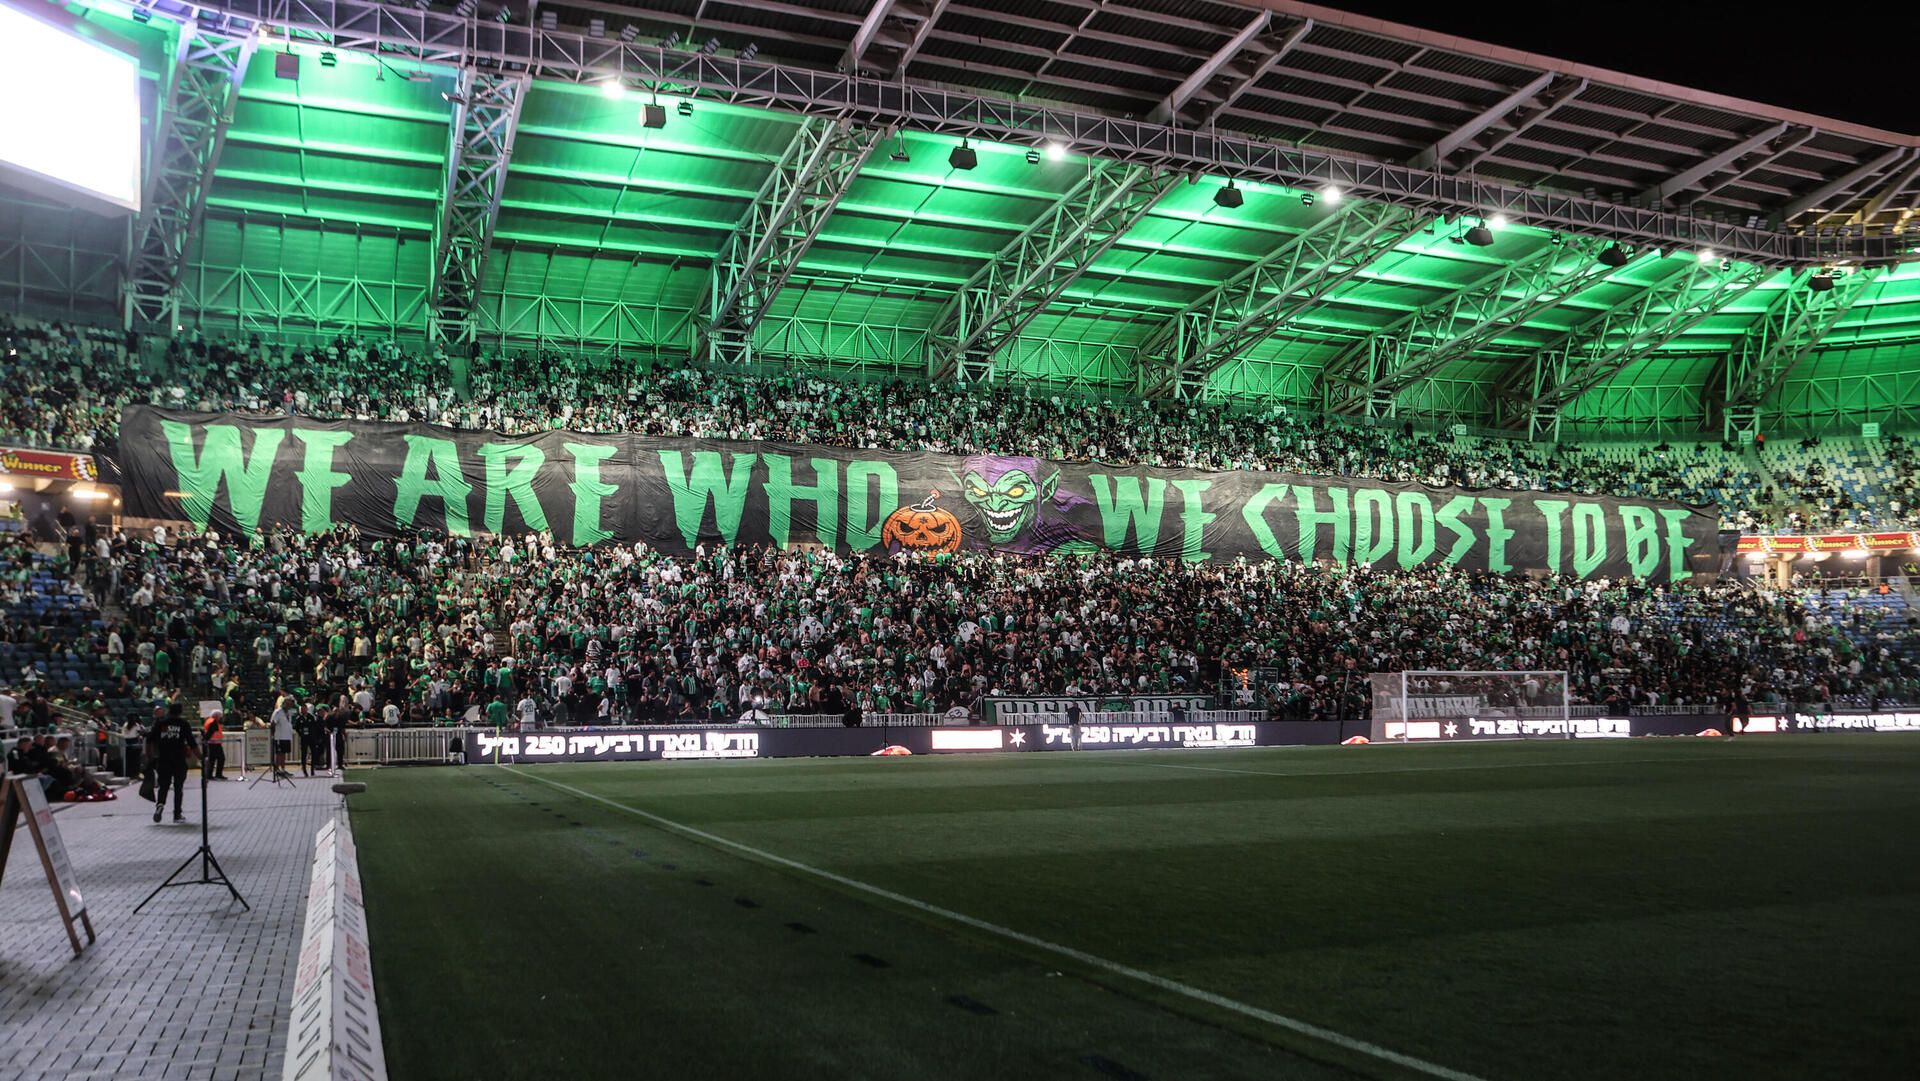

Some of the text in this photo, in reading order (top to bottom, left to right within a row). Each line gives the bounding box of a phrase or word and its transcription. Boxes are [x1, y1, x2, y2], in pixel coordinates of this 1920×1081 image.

[160, 420, 1695, 583] WE ARE WHO WE CHOOSE TO BE
[524, 735, 565, 754] 250
